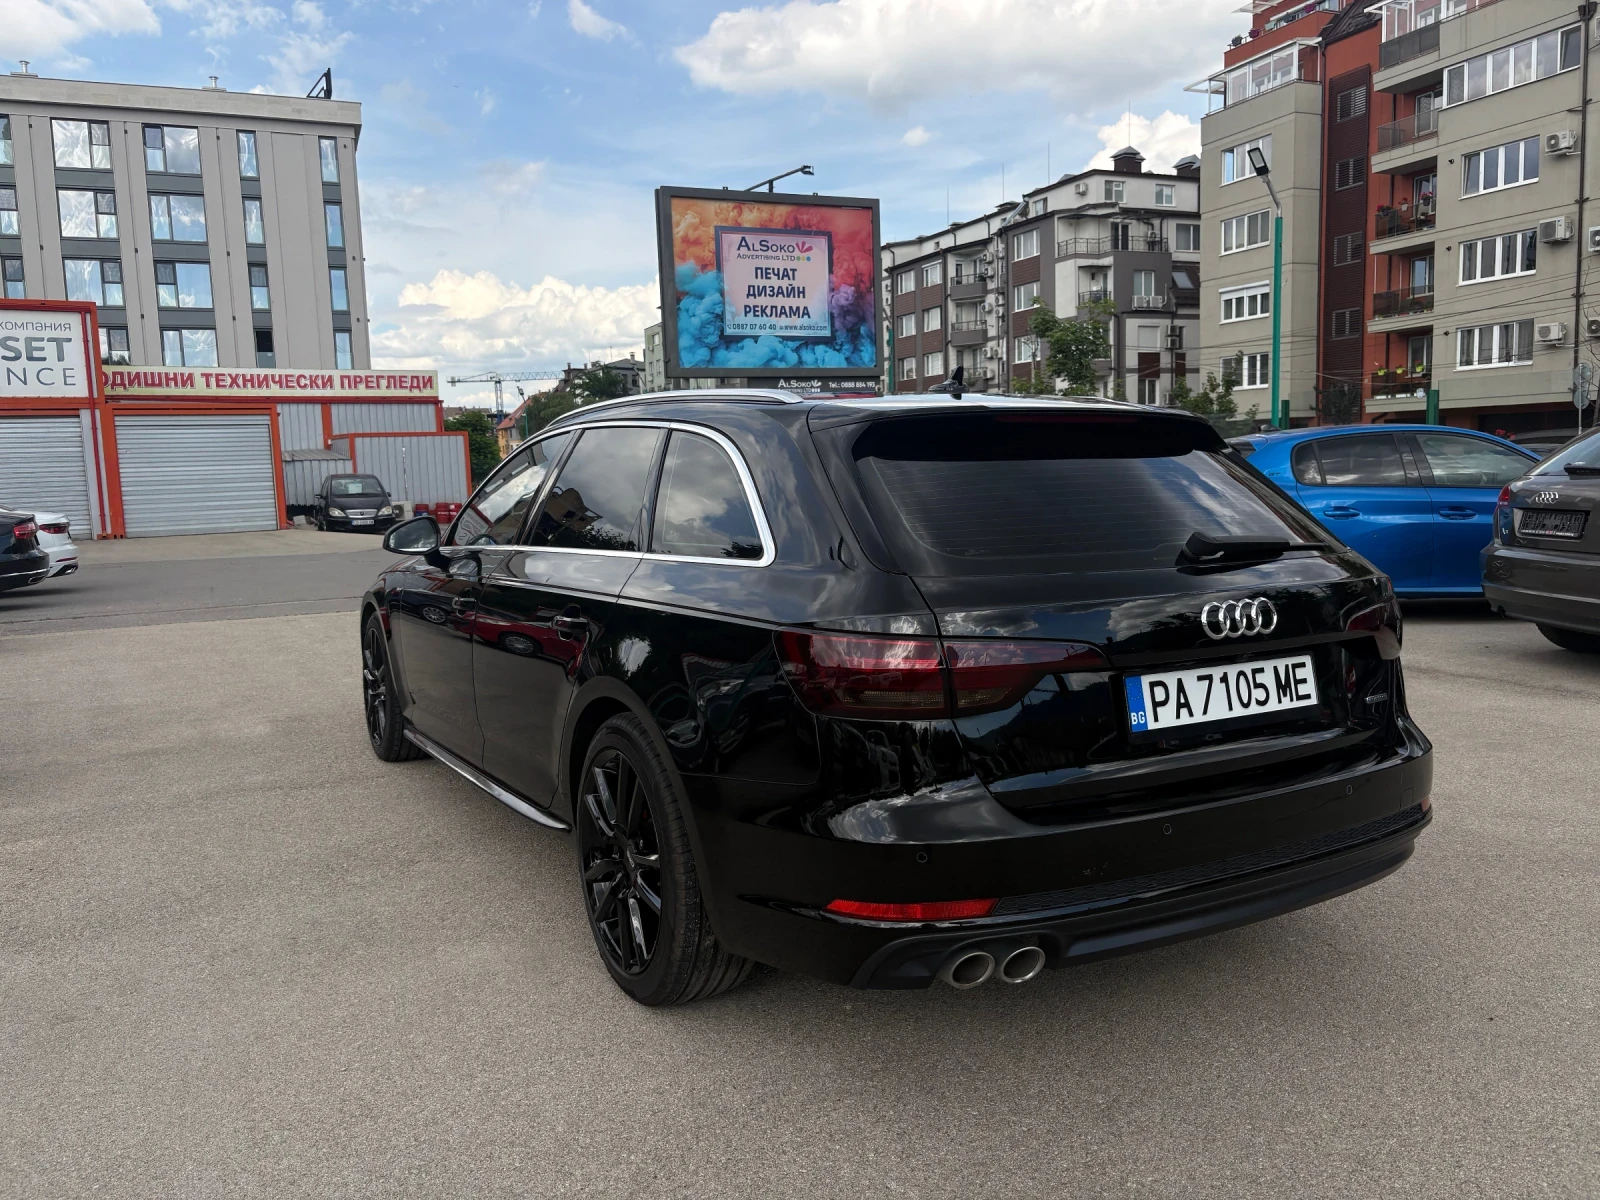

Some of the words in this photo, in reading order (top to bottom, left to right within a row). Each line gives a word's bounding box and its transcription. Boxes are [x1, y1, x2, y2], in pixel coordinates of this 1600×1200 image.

[754, 266, 797, 280] ПЕЧАТ
[746, 283, 806, 299] ДИЗАЙН
[743, 304, 811, 319] РЕКЛАМА
[732, 323, 748, 331] 0887
[749, 323, 758, 331] 07
[759, 323, 767, 331] 60
[768, 323, 777, 331] 40
[201, 372, 334, 390] ТЕХНИЧЕСКИ
[339, 374, 435, 392] ПРЕГЛЕДИ
[1130, 711, 1146, 725] BG
